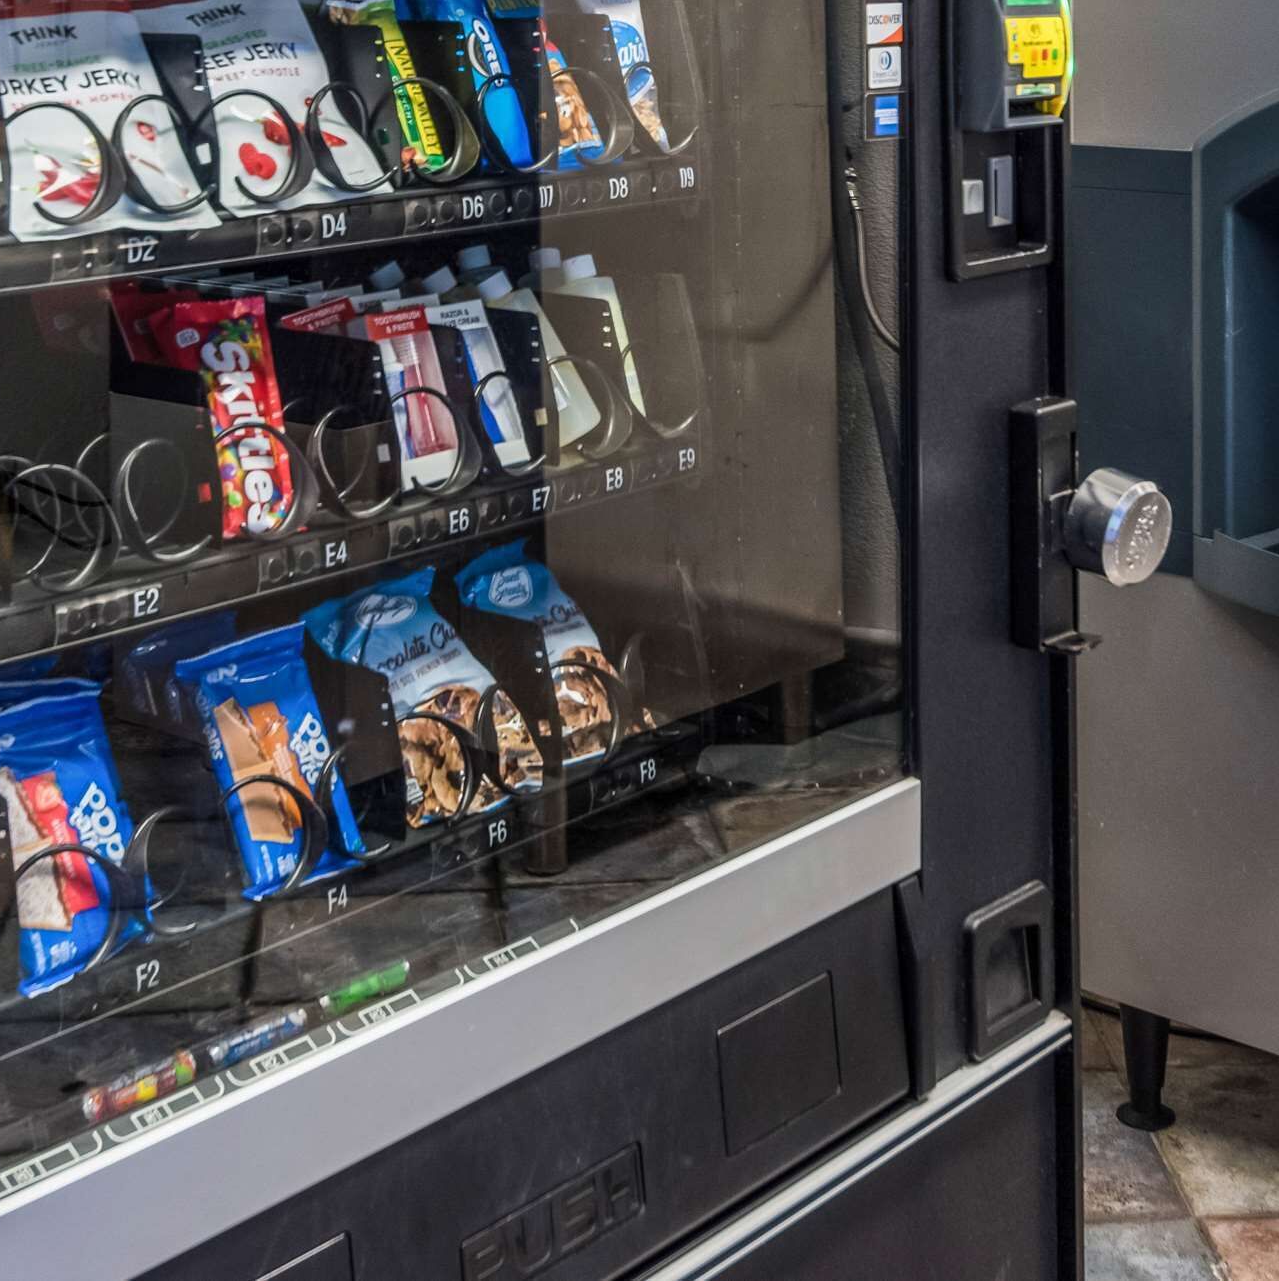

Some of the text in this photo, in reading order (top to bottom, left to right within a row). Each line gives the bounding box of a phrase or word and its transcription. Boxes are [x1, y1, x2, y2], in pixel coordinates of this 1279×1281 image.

[186, 3, 247, 28] THINK
[9, 24, 78, 46] THINK
[203, 41, 299, 70] EEF JERKY
[473, 20, 504, 87] OREO
[0, 67, 143, 97] URKEY JERKY
[609, 177, 629, 200] D8
[680, 166, 695, 189] D9
[462, 197, 484, 220] D6
[539, 185, 554, 209] D7
[322, 213, 348, 239] D4
[127, 236, 156, 263] D2
[678, 448, 696, 470] E9
[606, 467, 624, 492] E8
[532, 486, 552, 511] E7
[448, 509, 470, 534] E6
[325, 541, 348, 568] E4
[133, 588, 160, 618] E2
[639, 758, 657, 784] F8
[489, 820, 508, 847] F6
[327, 885, 348, 915] F4
[135, 959, 160, 992] F2
